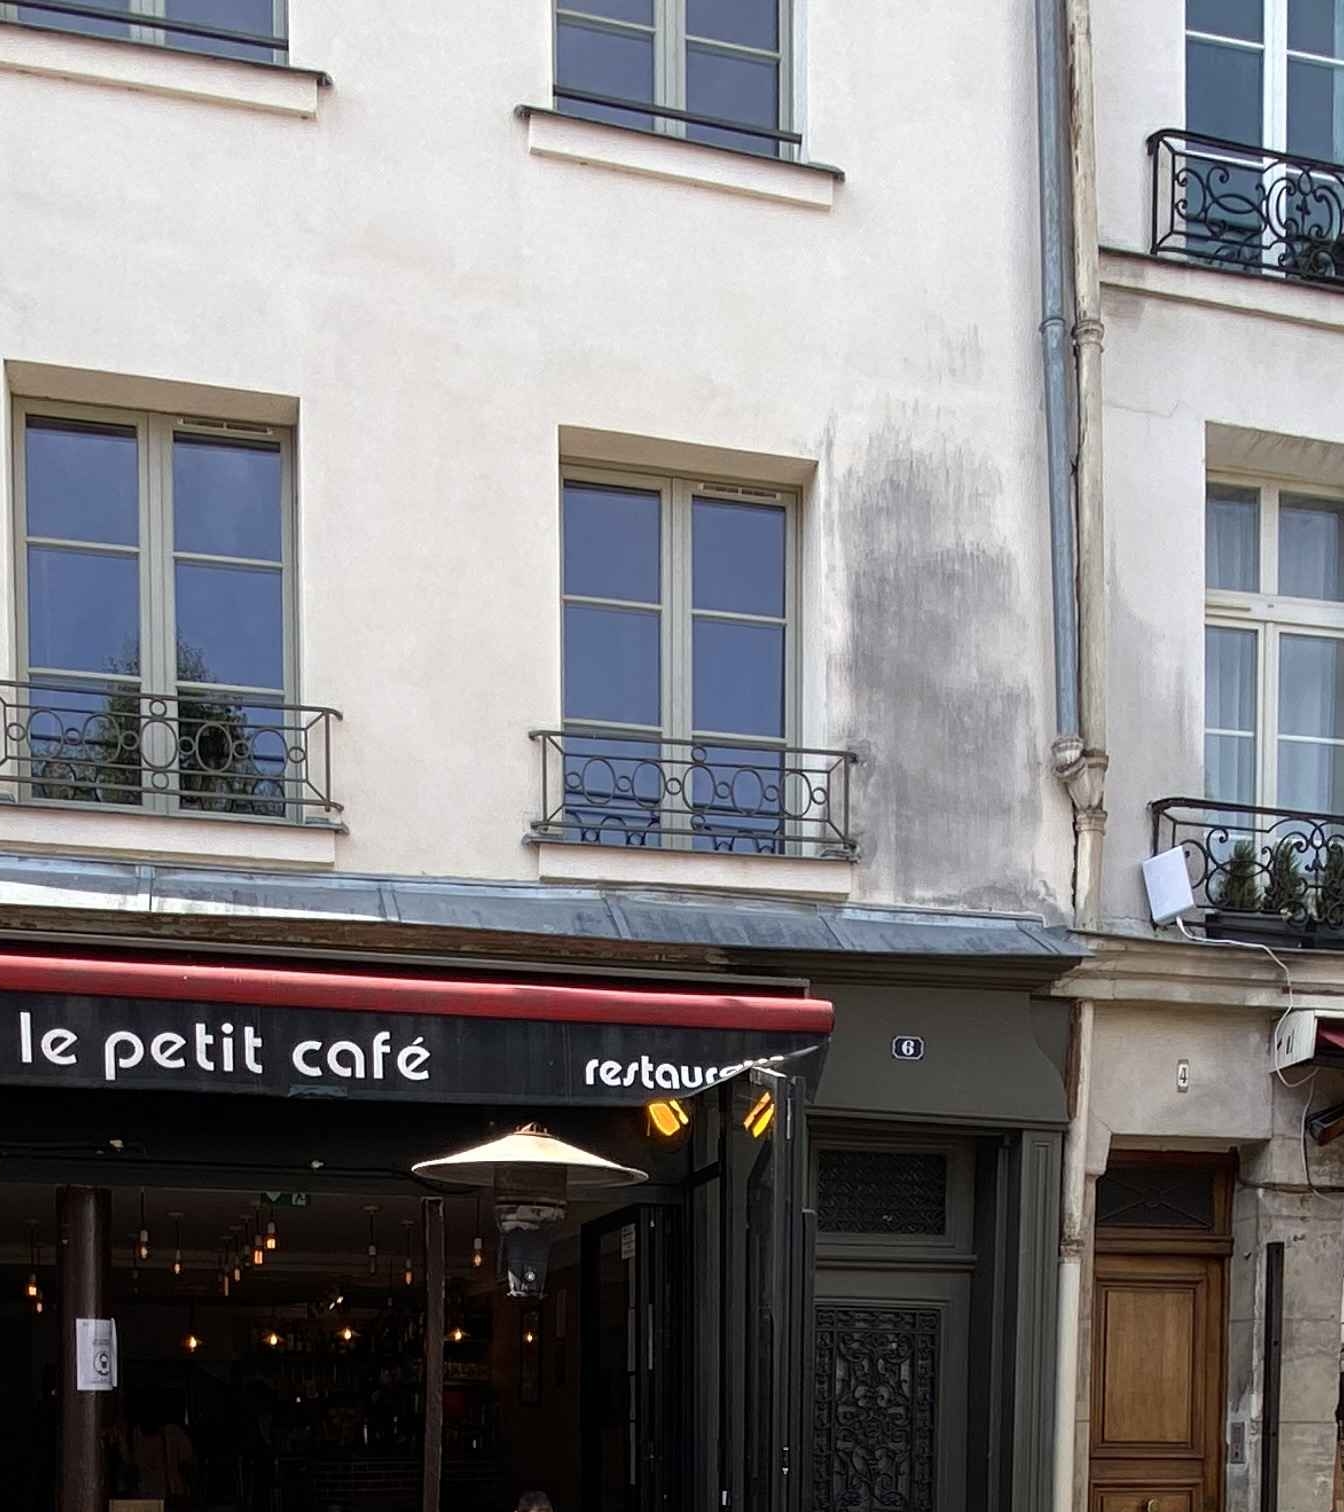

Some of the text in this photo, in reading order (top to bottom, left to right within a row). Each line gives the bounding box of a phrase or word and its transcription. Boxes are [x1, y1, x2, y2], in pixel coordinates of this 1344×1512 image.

[20, 1012, 431, 1080] le petit café
[902, 1040, 914, 1056] 6
[585, 1055, 784, 1089] restaur
